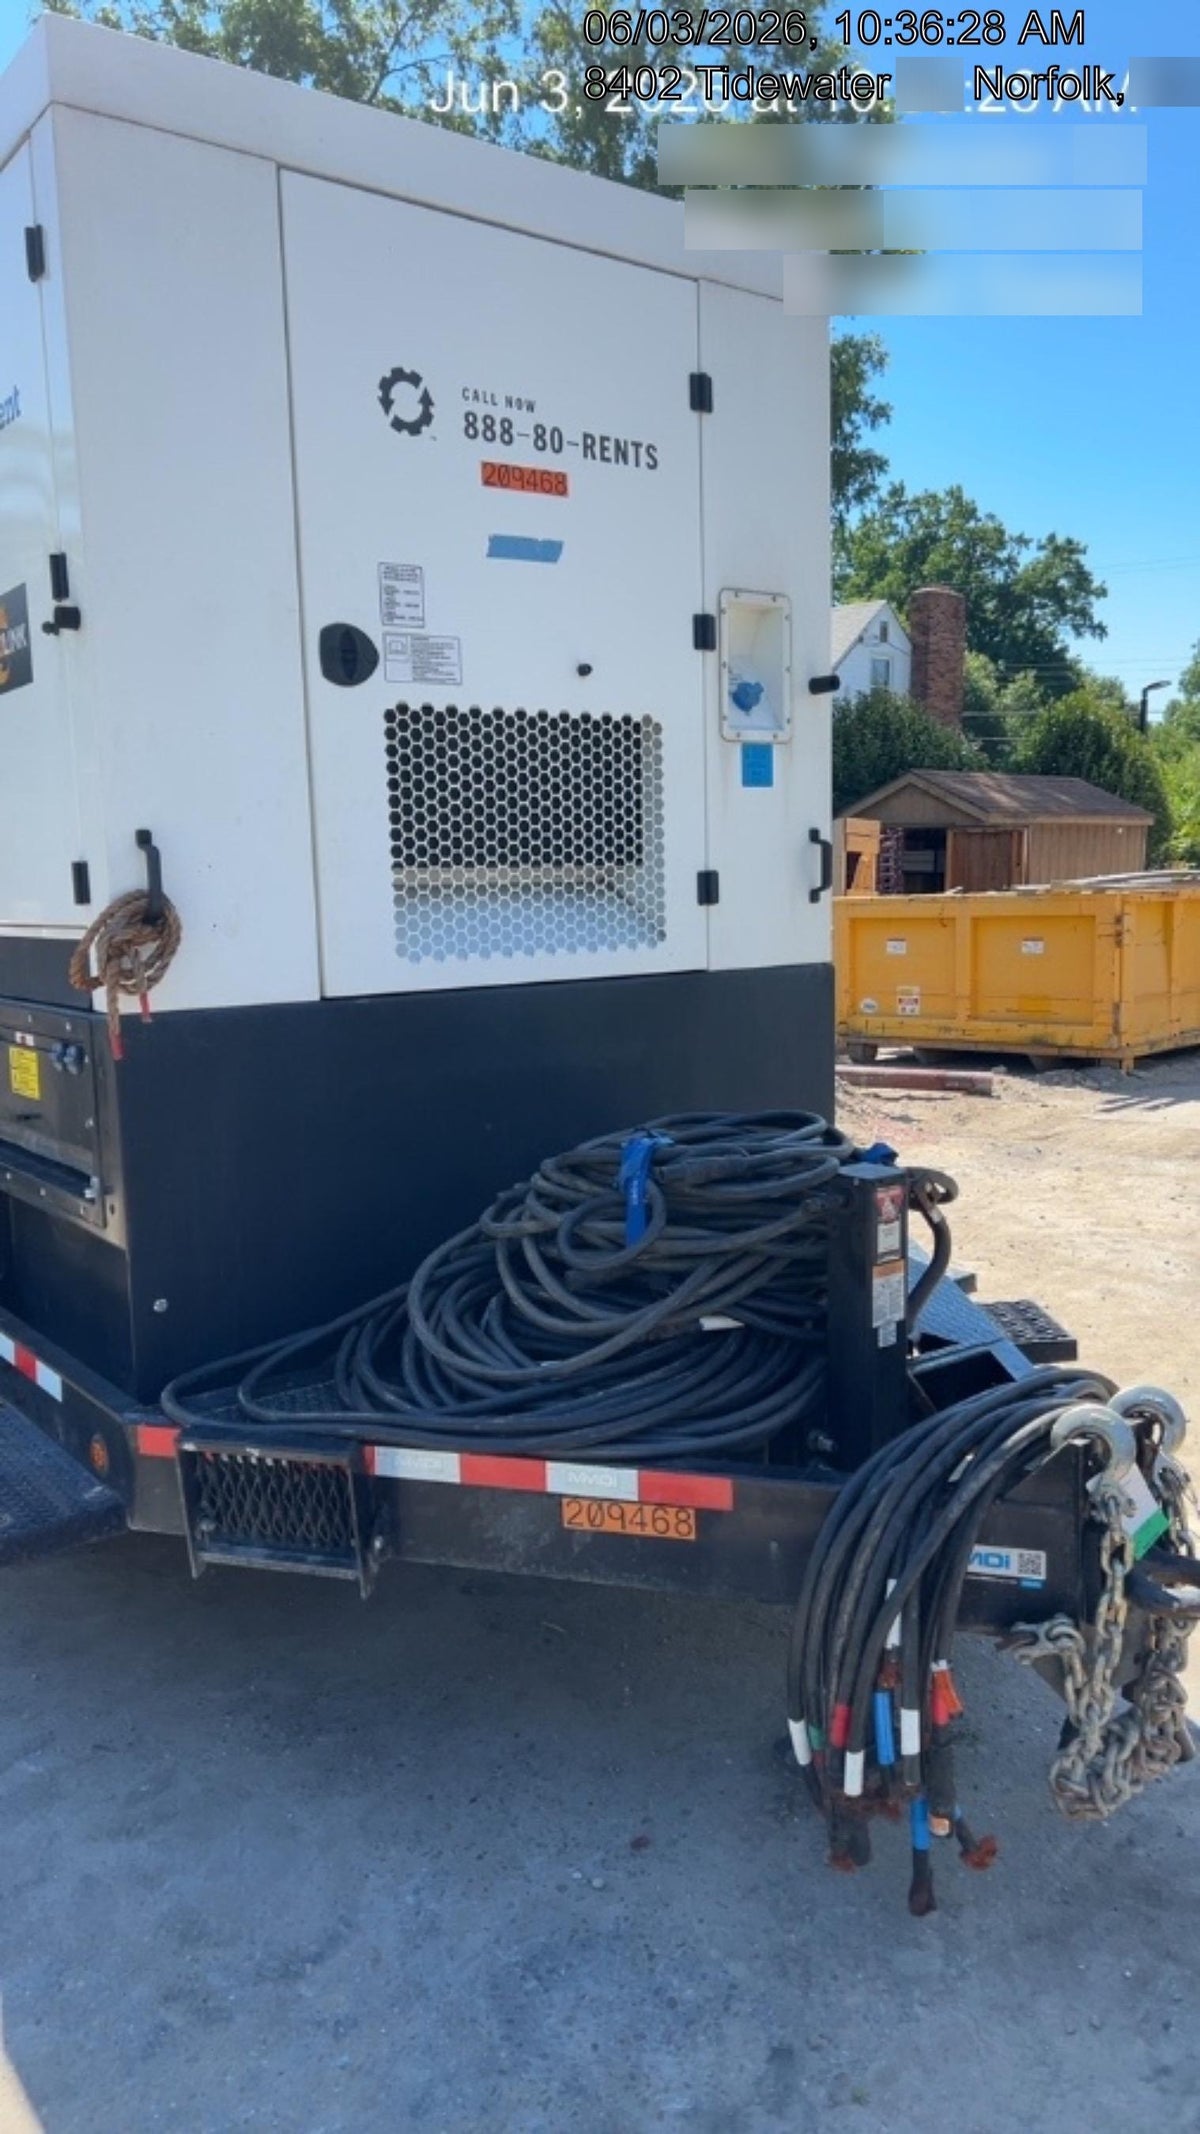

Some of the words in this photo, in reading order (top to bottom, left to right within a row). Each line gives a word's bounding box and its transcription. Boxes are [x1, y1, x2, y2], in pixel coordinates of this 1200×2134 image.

[462, 386, 498, 406] CALL
[505, 396, 536, 413] NOW
[464, 411, 658, 470] 888-80-RENTS
[482, 462, 567, 495] 209468
[566, 1500, 693, 1536] 209468
